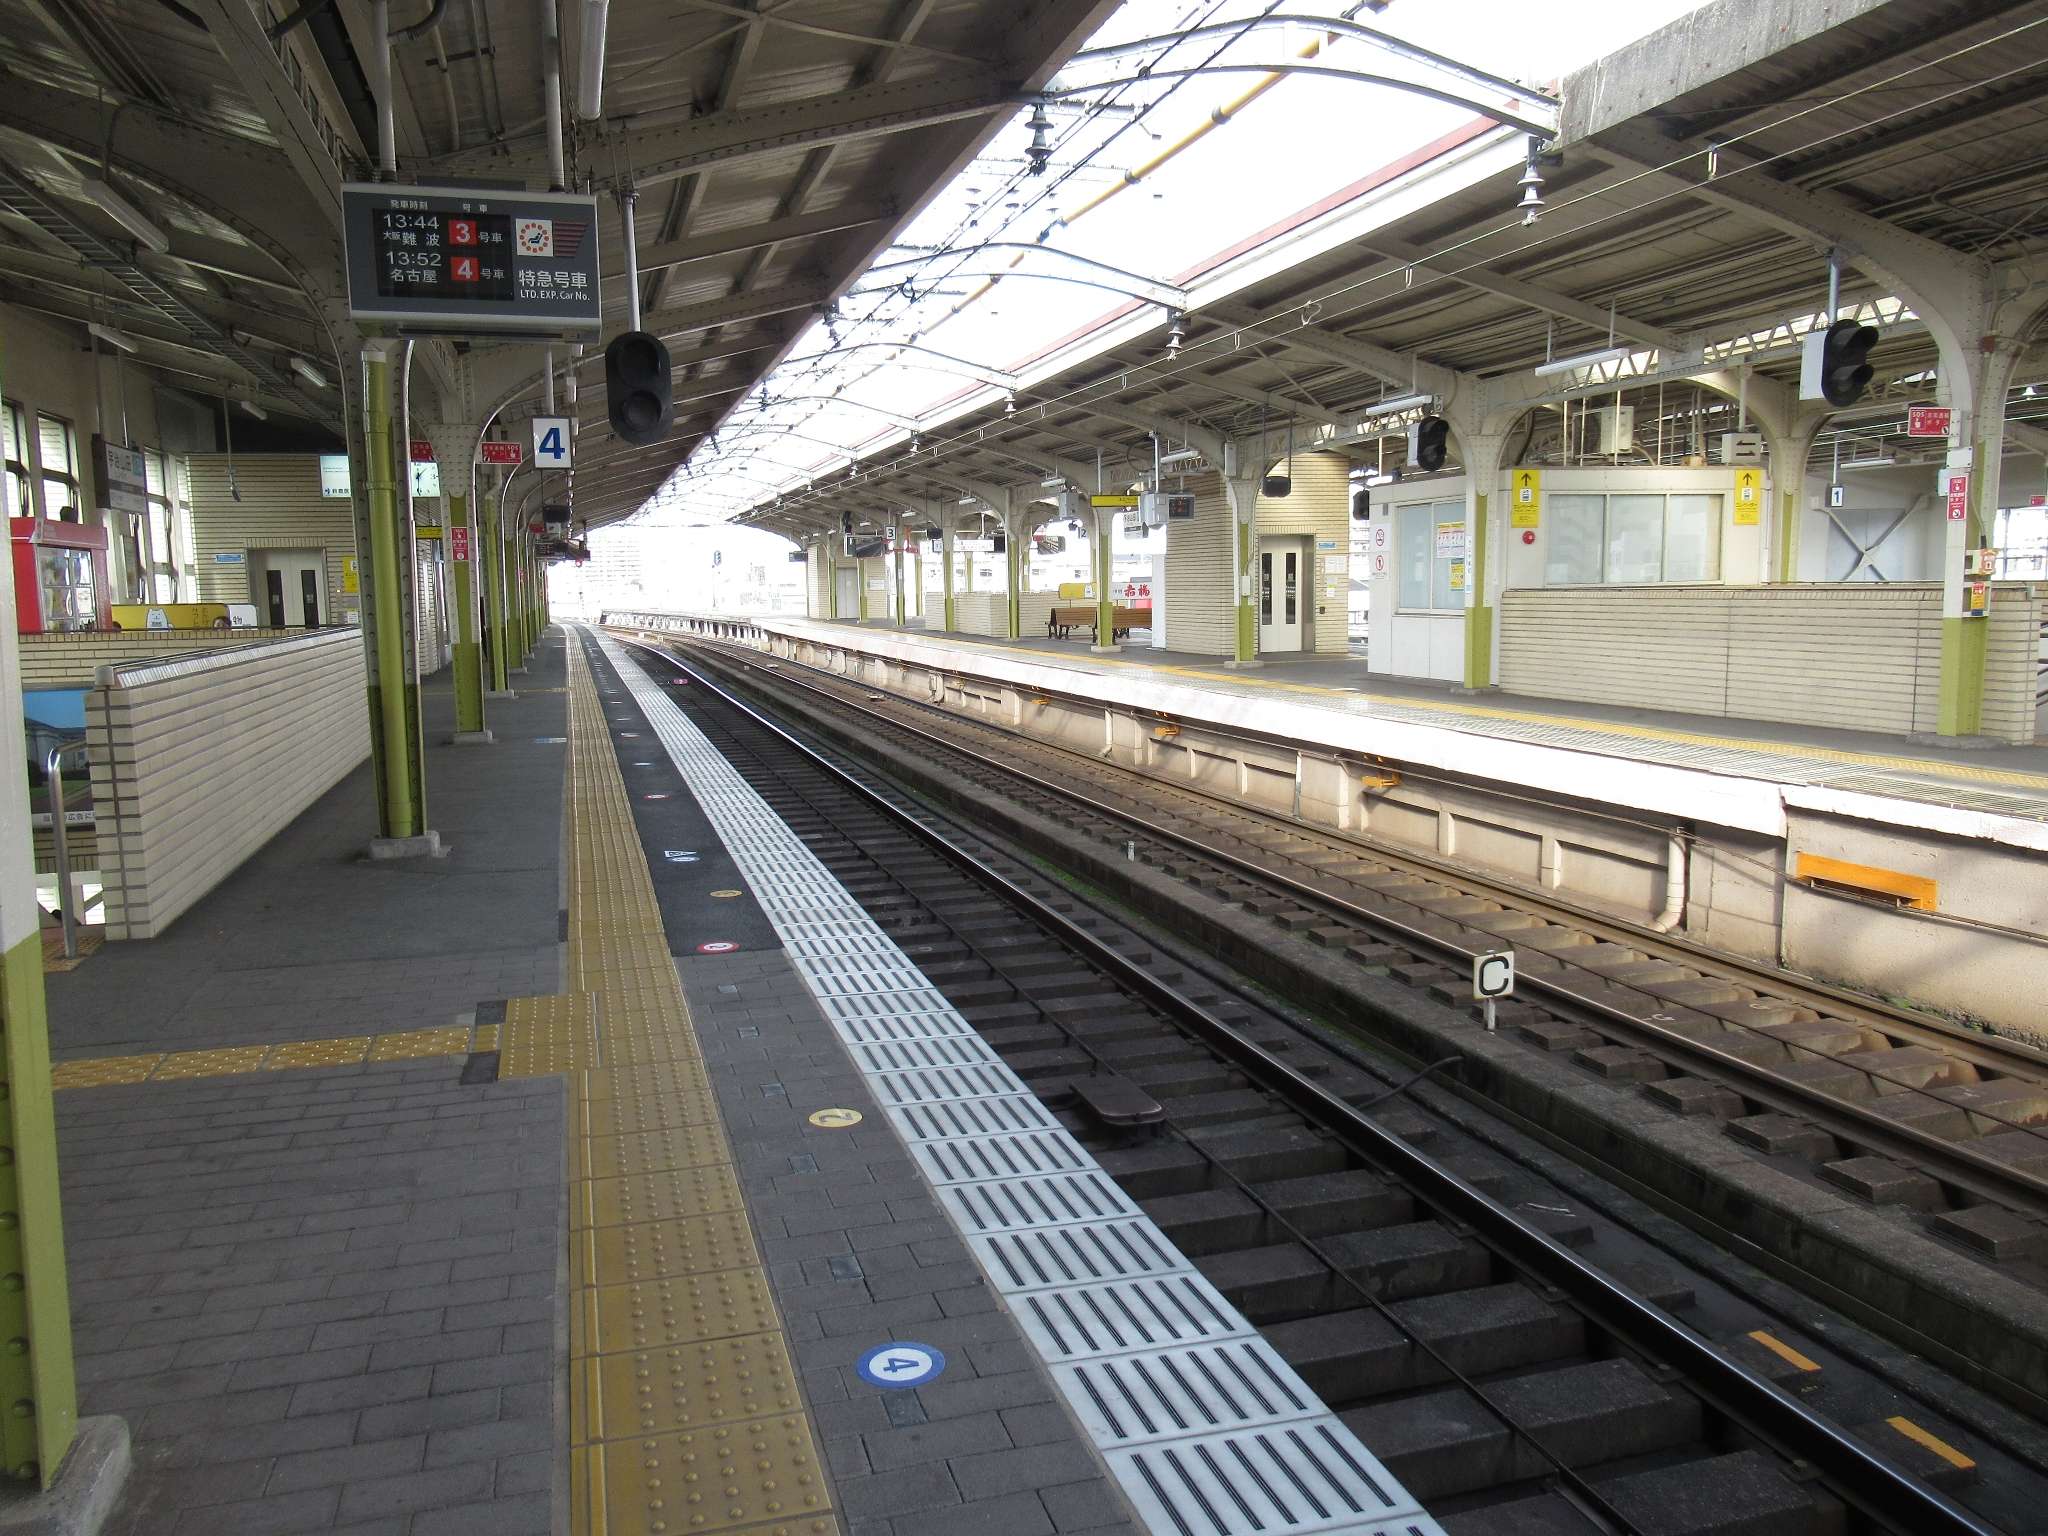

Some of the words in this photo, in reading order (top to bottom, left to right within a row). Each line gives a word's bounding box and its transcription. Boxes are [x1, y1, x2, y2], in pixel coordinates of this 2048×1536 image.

[391, 200, 428, 210] 発車時刻
[384, 213, 440, 229] 13:44
[456, 223, 471, 243] 3
[480, 232, 503, 243] 号車
[386, 251, 441, 267] 13:52
[390, 269, 438, 283] 名古屋
[458, 259, 472, 279] 4
[481, 268, 504, 280] 号車
[518, 269, 588, 289] 特急号車
[520, 289, 539, 299] LTD.
[540, 290, 559, 300] EXP.
[560, 291, 574, 300] Car
[575, 291, 591, 301] No.
[538, 427, 566, 460] 4
[1834, 490, 1840, 504] 1
[887, 528, 894, 538] 3
[1080, 528, 1087, 538] 2
[1478, 955, 1510, 996] C
[883, 1357, 920, 1373] 4
